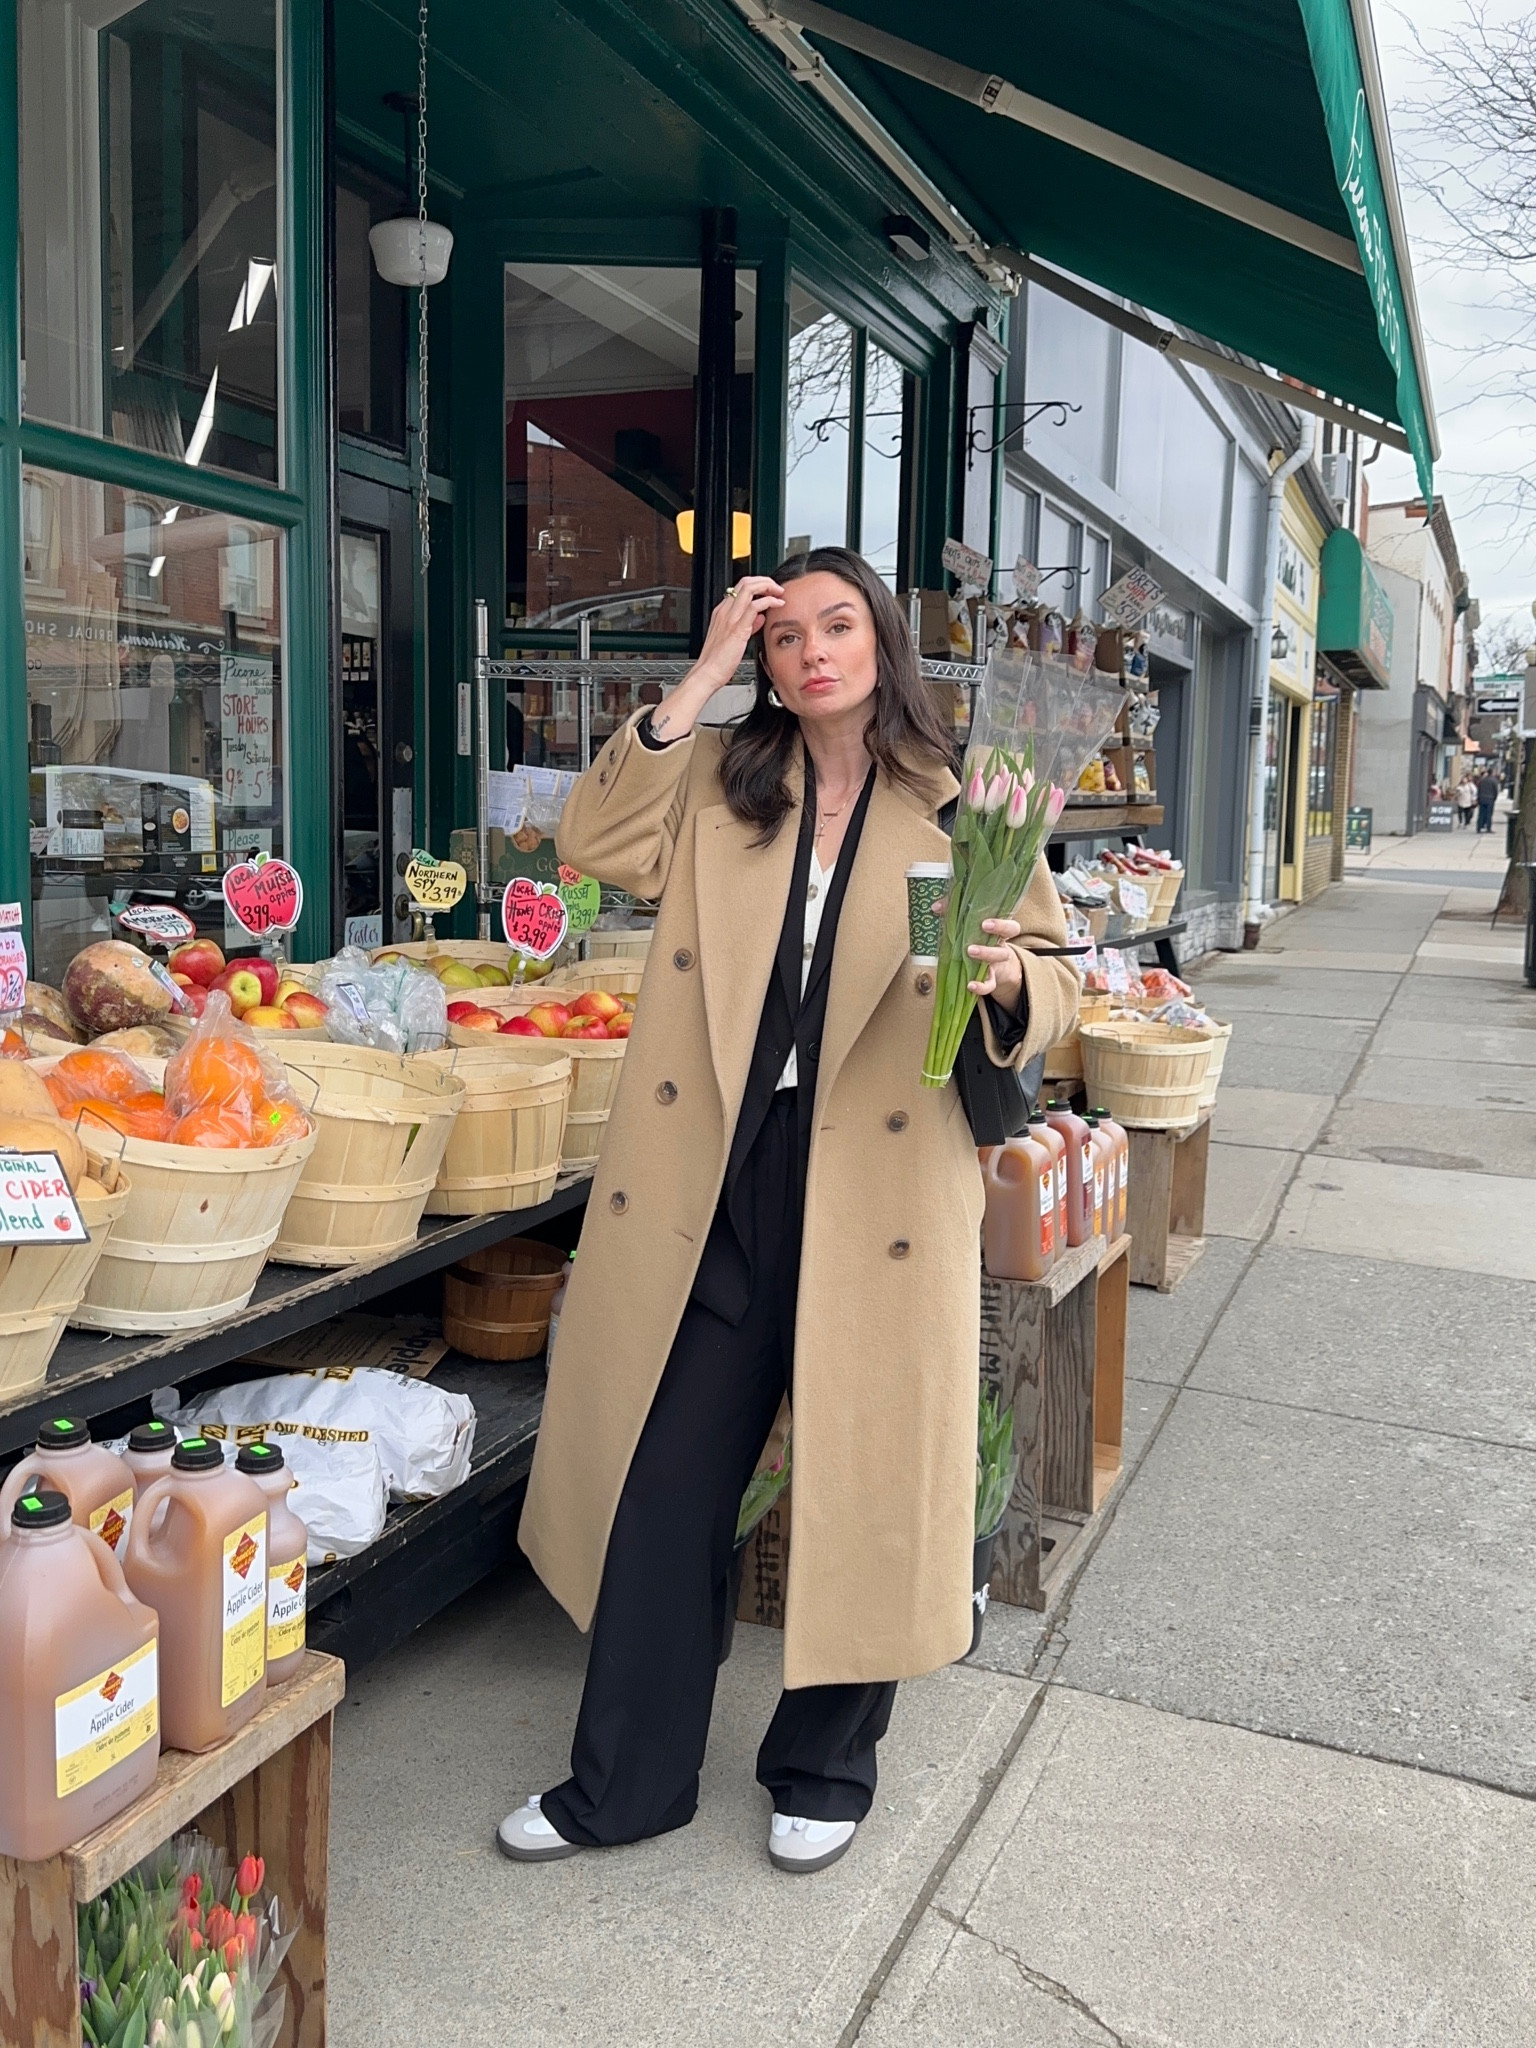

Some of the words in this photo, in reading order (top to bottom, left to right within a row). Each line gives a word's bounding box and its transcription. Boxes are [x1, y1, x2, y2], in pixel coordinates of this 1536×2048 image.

[223, 656, 266, 686] Picone
[223, 694, 258, 716] STORE
[237, 715, 268, 734] HOURS
[223, 737, 247, 760] Tuesday
[246, 749, 272, 770] Saturday
[1431, 806, 1453, 814] NOW
[1428, 816, 1451, 825] OPEN
[228, 829, 260, 850] Please
[414, 850, 437, 867] LOCAL
[408, 865, 458, 881] NORTHERN
[413, 878, 437, 892] SPY
[510, 878, 538, 898] LOCAL
[561, 883, 592, 903] RUSSET
[125, 905, 157, 917] LOCAL
[348, 921, 379, 947] Easter
[6, 1179, 71, 1200] CIDER
[0, 1203, 45, 1231] lend
[302, 1425, 370, 1443] FLESHED
[226, 1596, 247, 1617] Apple
[247, 1580, 264, 1601] Cider
[272, 1599, 298, 1618] Apple
[89, 1709, 114, 1735] Apple
[115, 1697, 135, 1718] Cider
